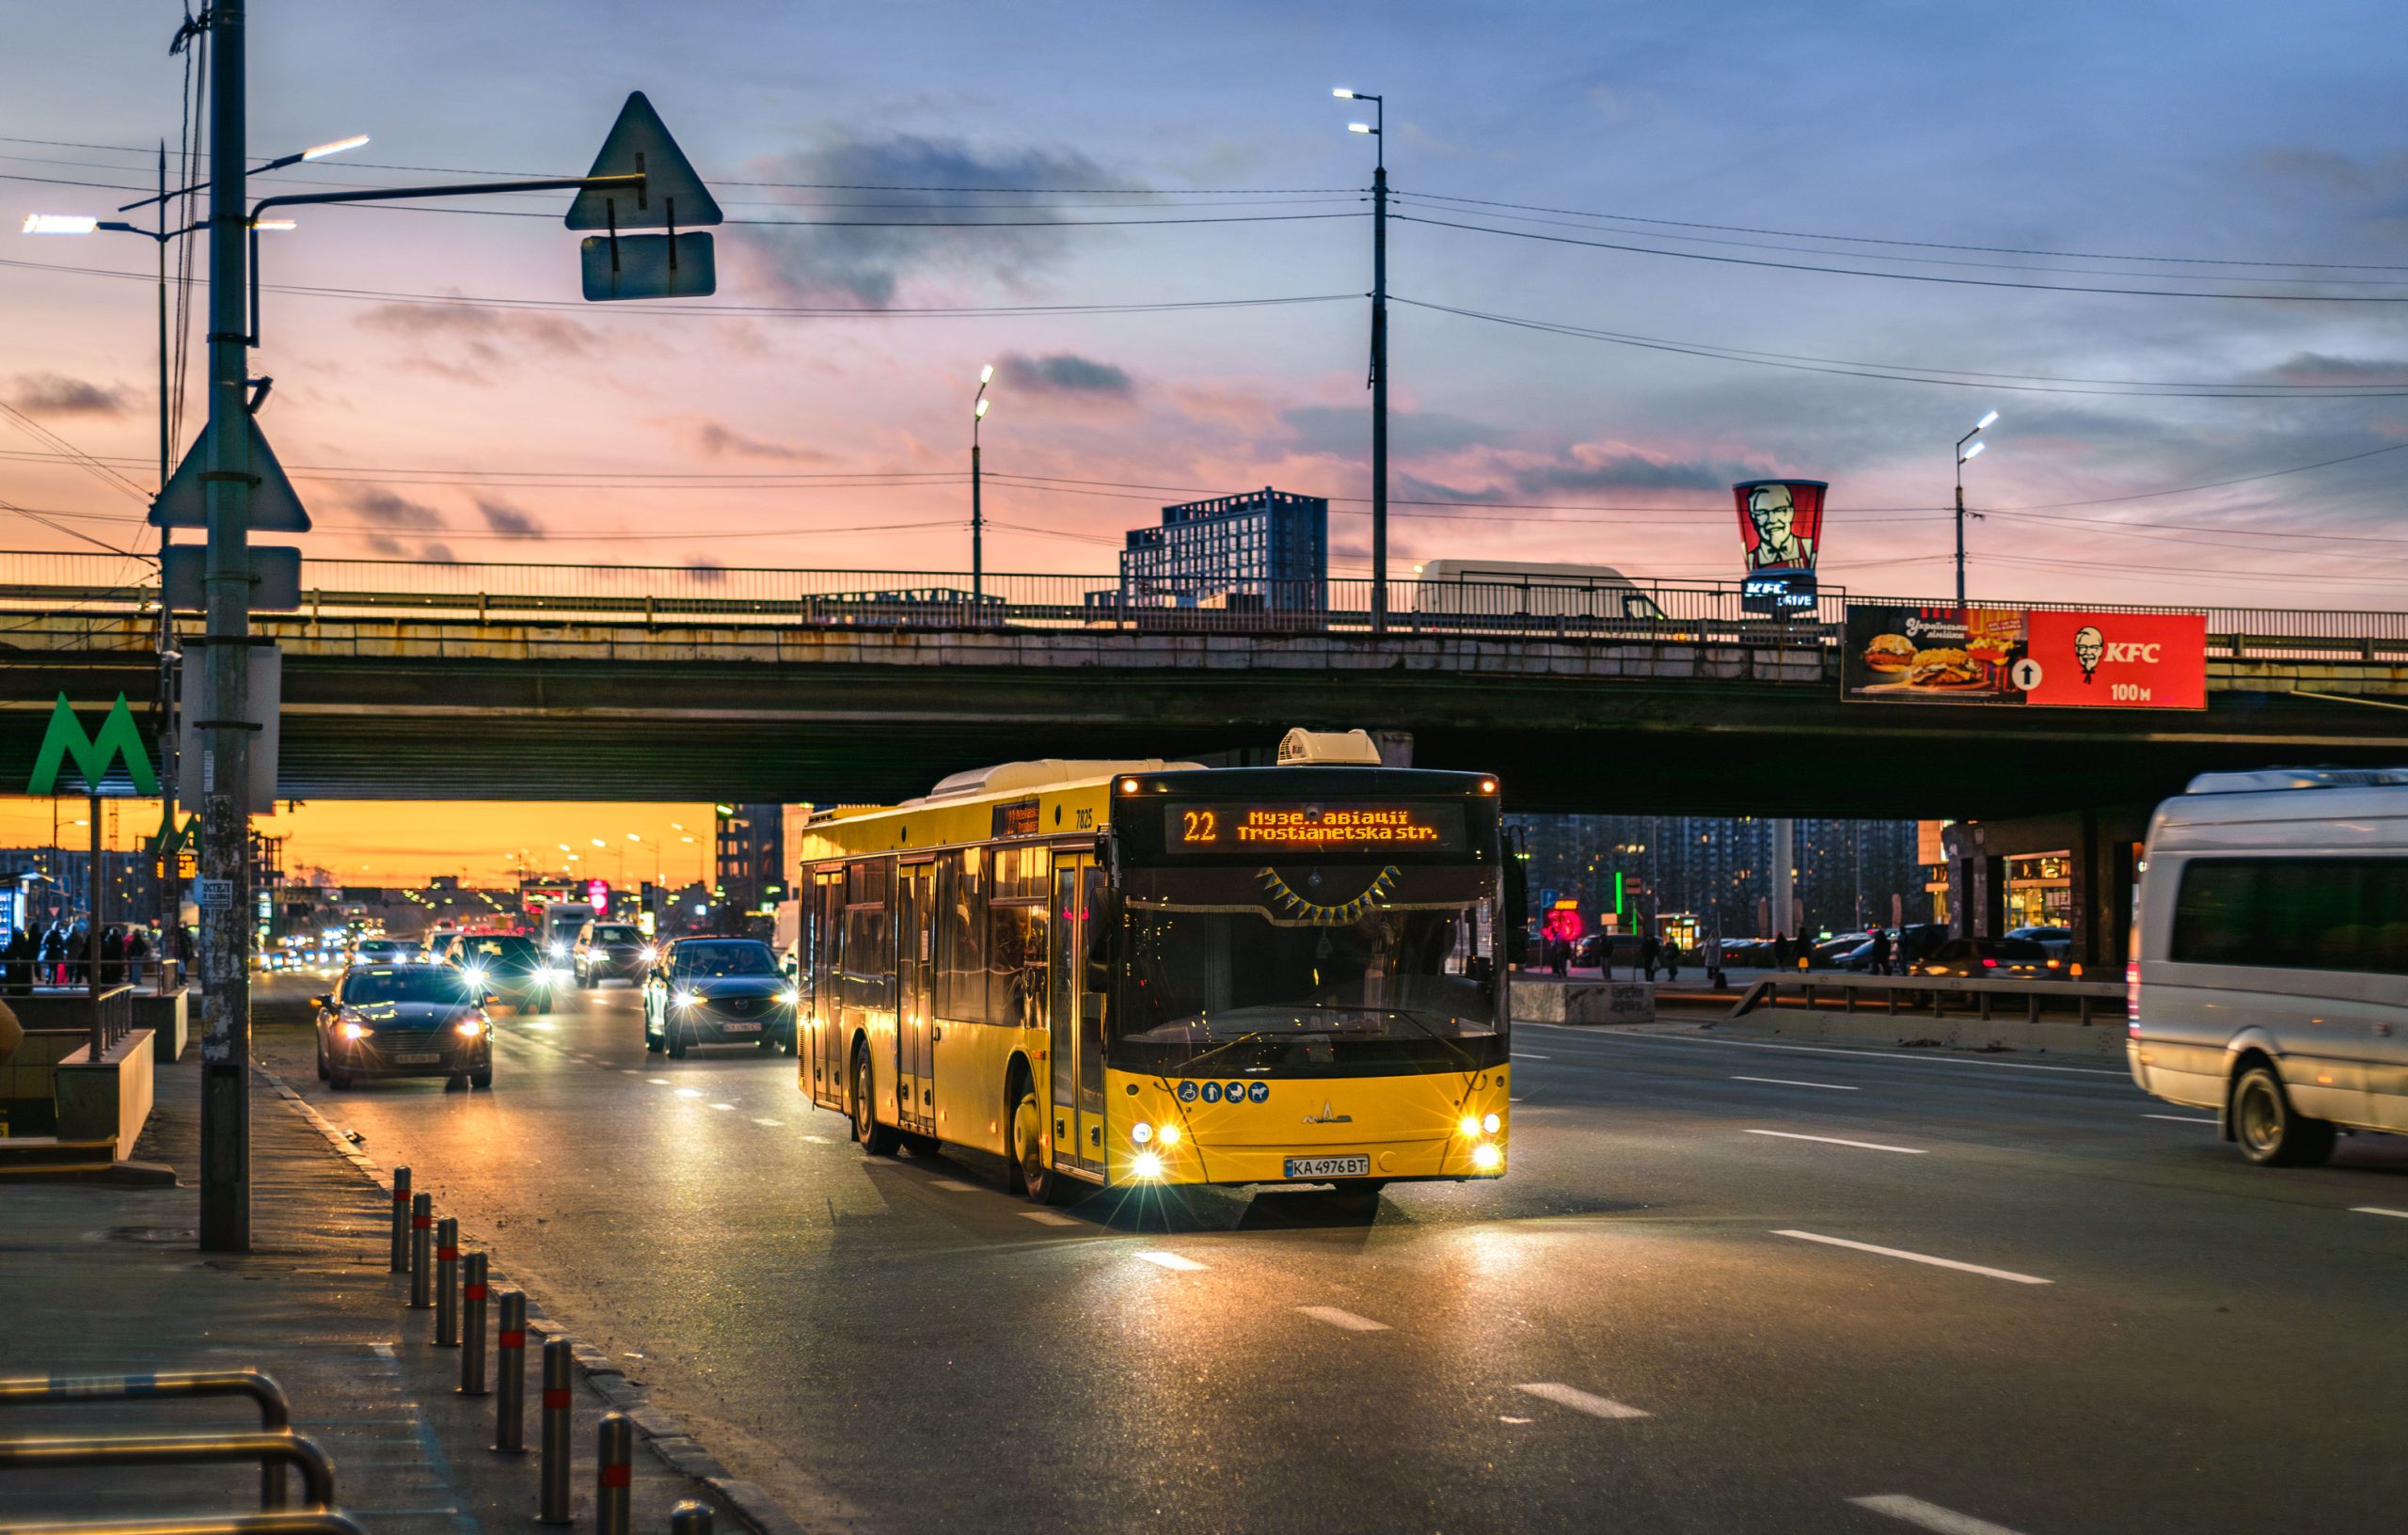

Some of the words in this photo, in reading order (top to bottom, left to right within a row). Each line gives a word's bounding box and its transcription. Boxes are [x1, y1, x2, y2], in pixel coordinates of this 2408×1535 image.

[2103, 641, 2162, 663] KFC
[1075, 808, 1093, 830] 7825
[1183, 812, 1216, 840] 22
[1249, 812, 1318, 825] Музе
[1323, 811, 1408, 825] авіації
[1237, 827, 1392, 840] Trostianetska
[1395, 826, 1438, 839] str.
